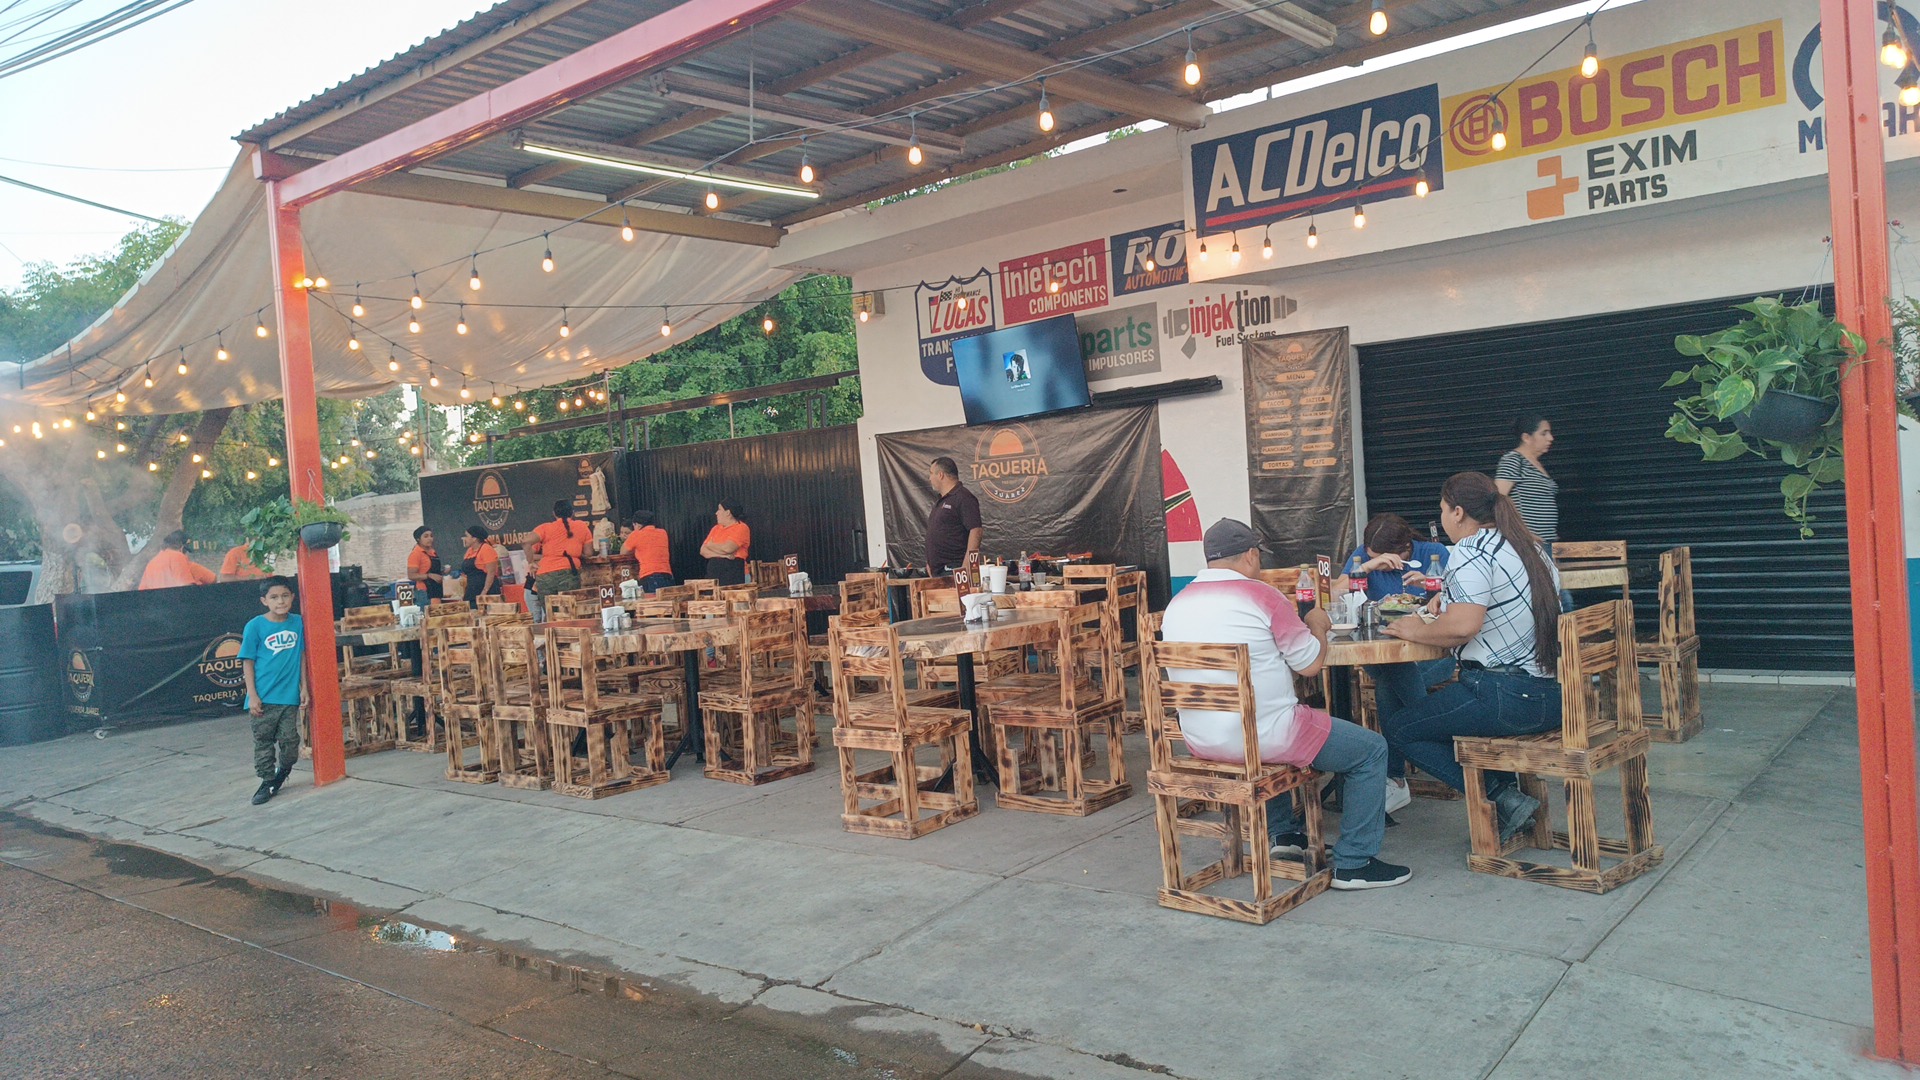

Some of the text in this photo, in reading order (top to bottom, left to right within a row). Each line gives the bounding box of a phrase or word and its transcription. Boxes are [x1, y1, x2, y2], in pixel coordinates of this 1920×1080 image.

[1518, 30, 1776, 148] BOSCH
[1206, 107, 1431, 213] ACDelco
[1587, 129, 1697, 180] EXIM
[1588, 173, 1668, 209] PARTS
[1029, 285, 1107, 315] COMPONENTS
[931, 295, 989, 334] LUCAS
[1216, 333, 1235, 348] Fuel
[1089, 349, 1155, 372] IMPULSORES
[970, 457, 1049, 480] TAQUERIA
[473, 497, 515, 513] TAQUERIA
[785, 556, 797, 567] 05
[969, 552, 979, 563] 07
[621, 568, 630, 577] 03
[1318, 560, 1330, 577] 08
[955, 570, 968, 585] 06
[400, 590, 412, 600] 02
[601, 587, 614, 599] 04
[198, 659, 243, 674] TAQUE
[193, 690, 238, 703] TAQUERIA
